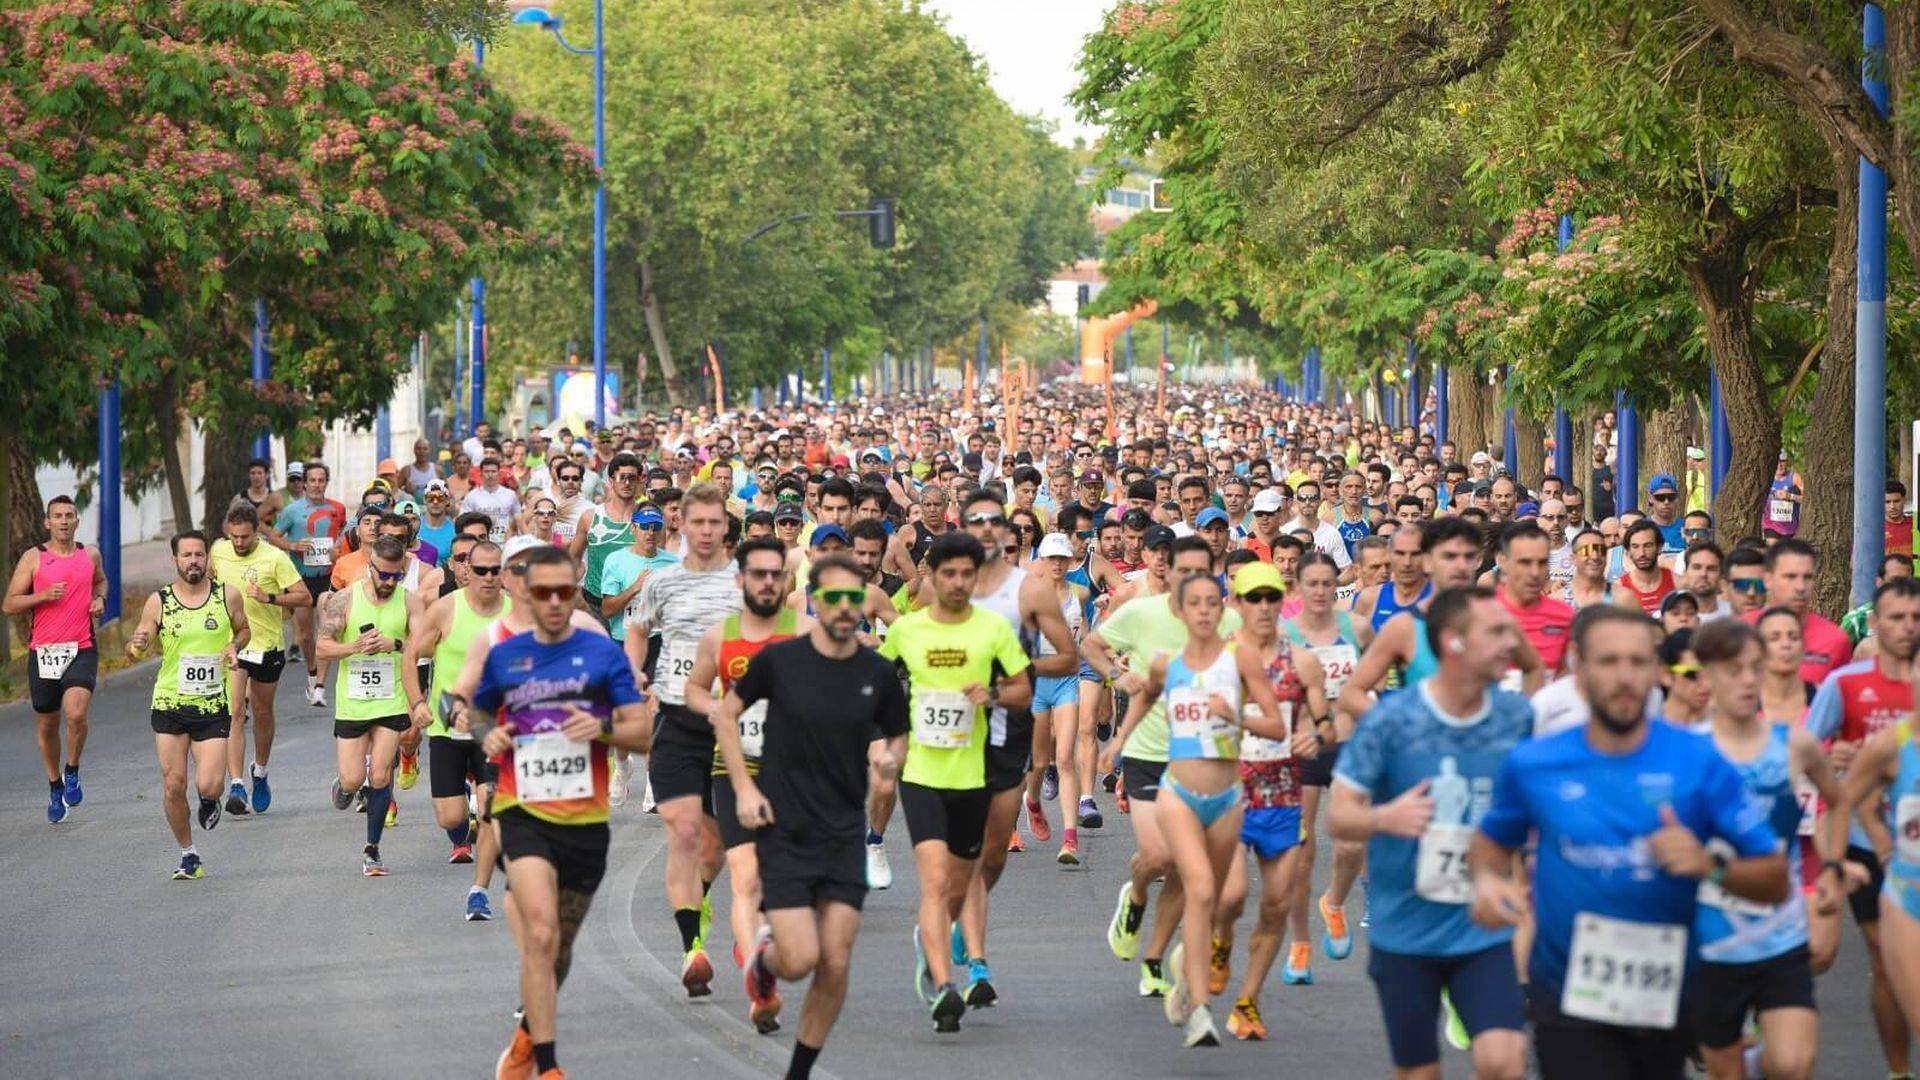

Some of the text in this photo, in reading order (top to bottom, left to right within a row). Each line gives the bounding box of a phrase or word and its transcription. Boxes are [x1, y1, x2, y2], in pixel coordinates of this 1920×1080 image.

[186, 667, 214, 681] 801
[361, 671, 381, 685] 55
[924, 706, 965, 727] 357
[520, 756, 587, 778] 13429
